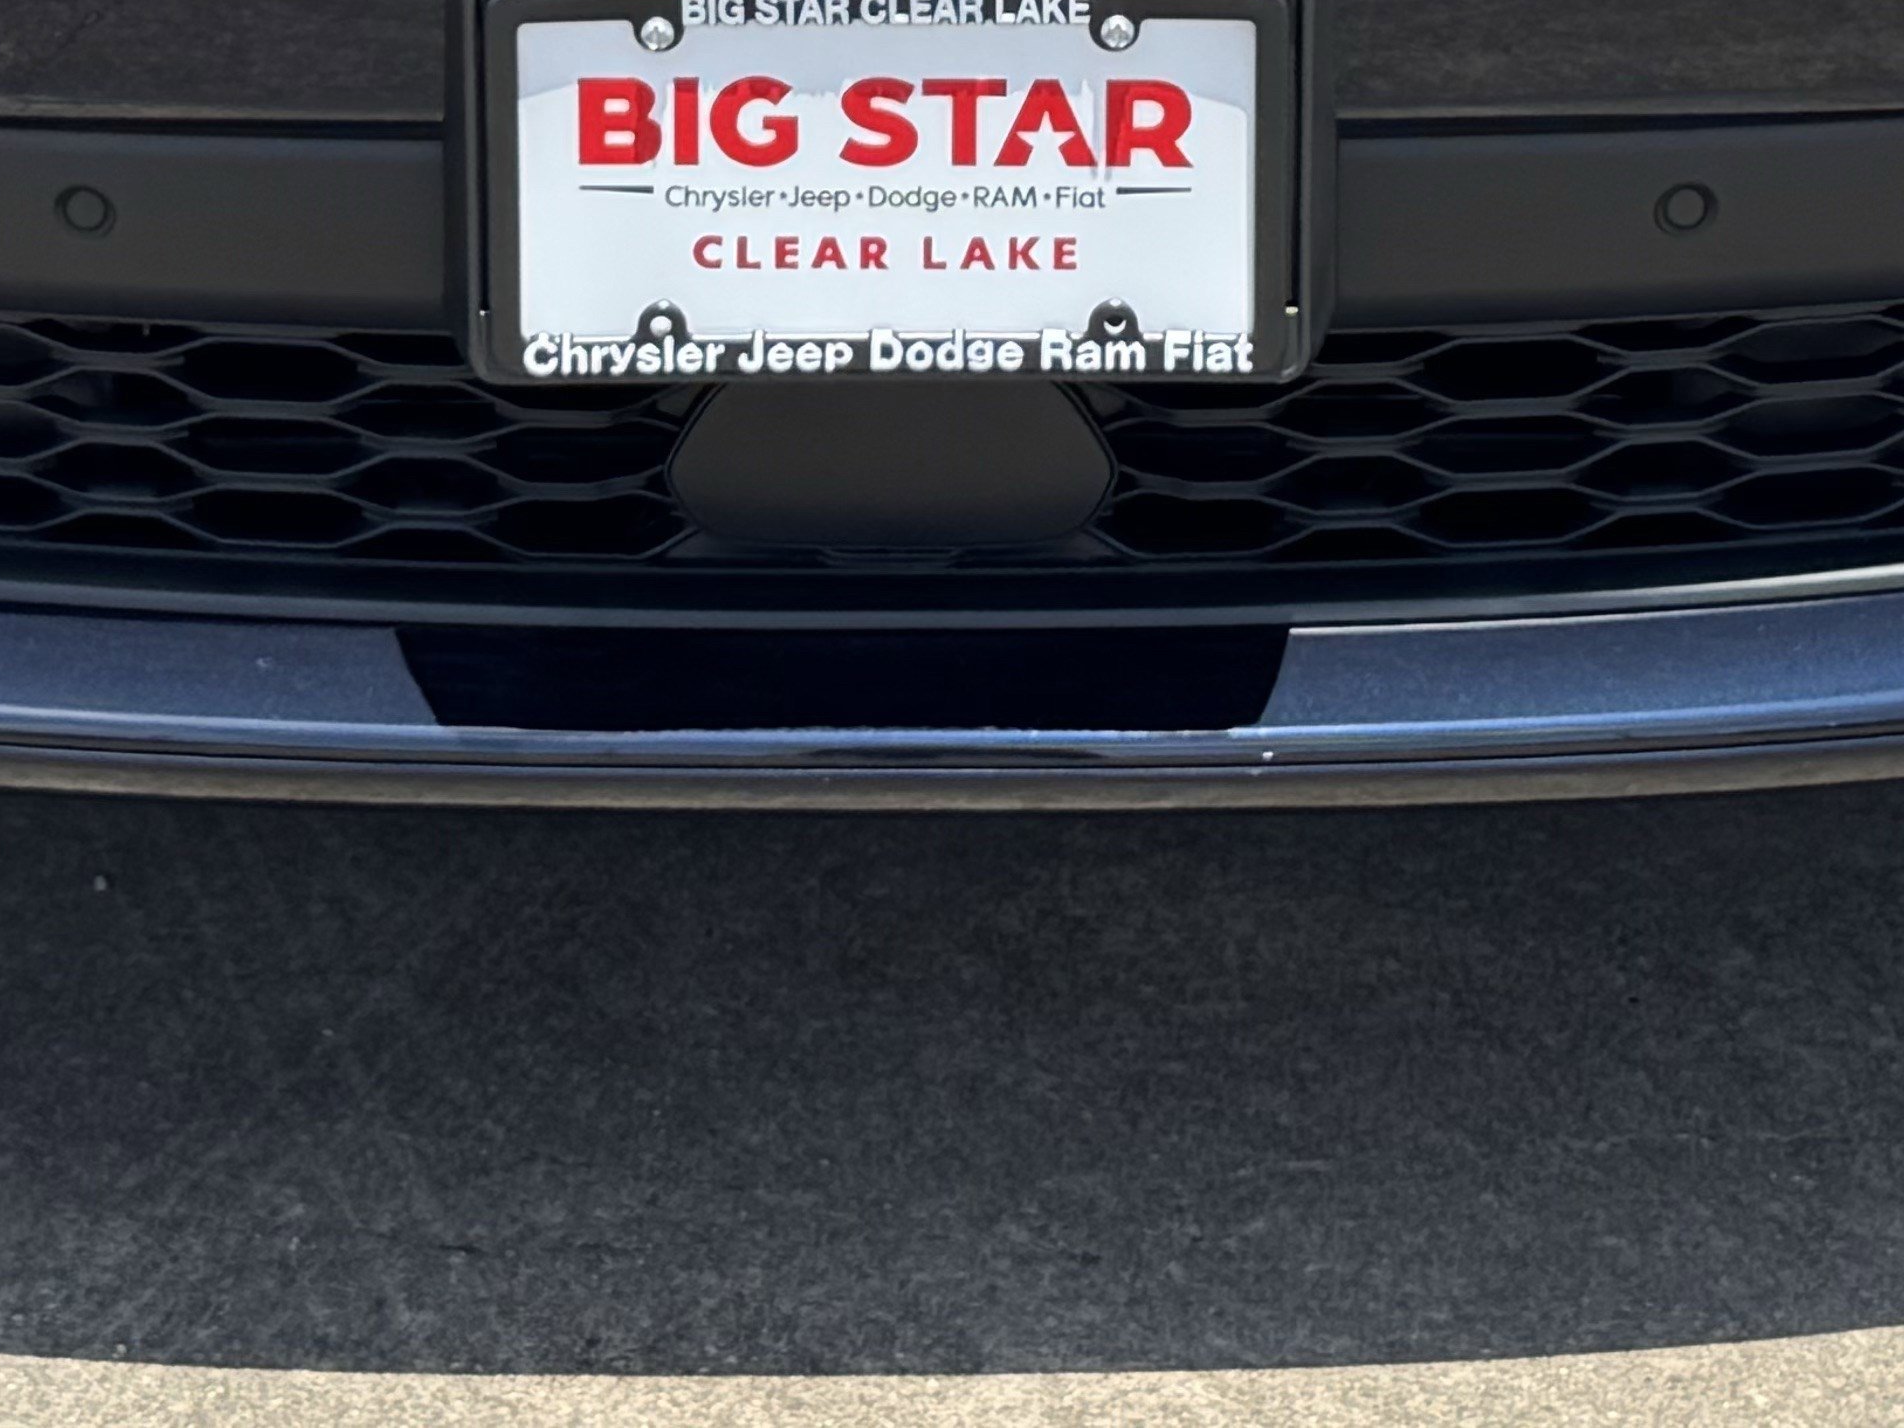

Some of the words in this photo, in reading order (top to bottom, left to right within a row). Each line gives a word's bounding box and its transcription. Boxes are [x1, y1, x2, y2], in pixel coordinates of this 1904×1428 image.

[578, 76, 798, 166] BIG
[839, 76, 1194, 168] STAR
[693, 235, 889, 270] CLEAR
[923, 235, 1080, 271] LAKE
[523, 332, 725, 376] Chrysler
[738, 329, 853, 373] Jeep
[870, 328, 1025, 372] Dodge
[1040, 328, 1147, 372] Ram
[1164, 329, 1254, 373] Fiat
